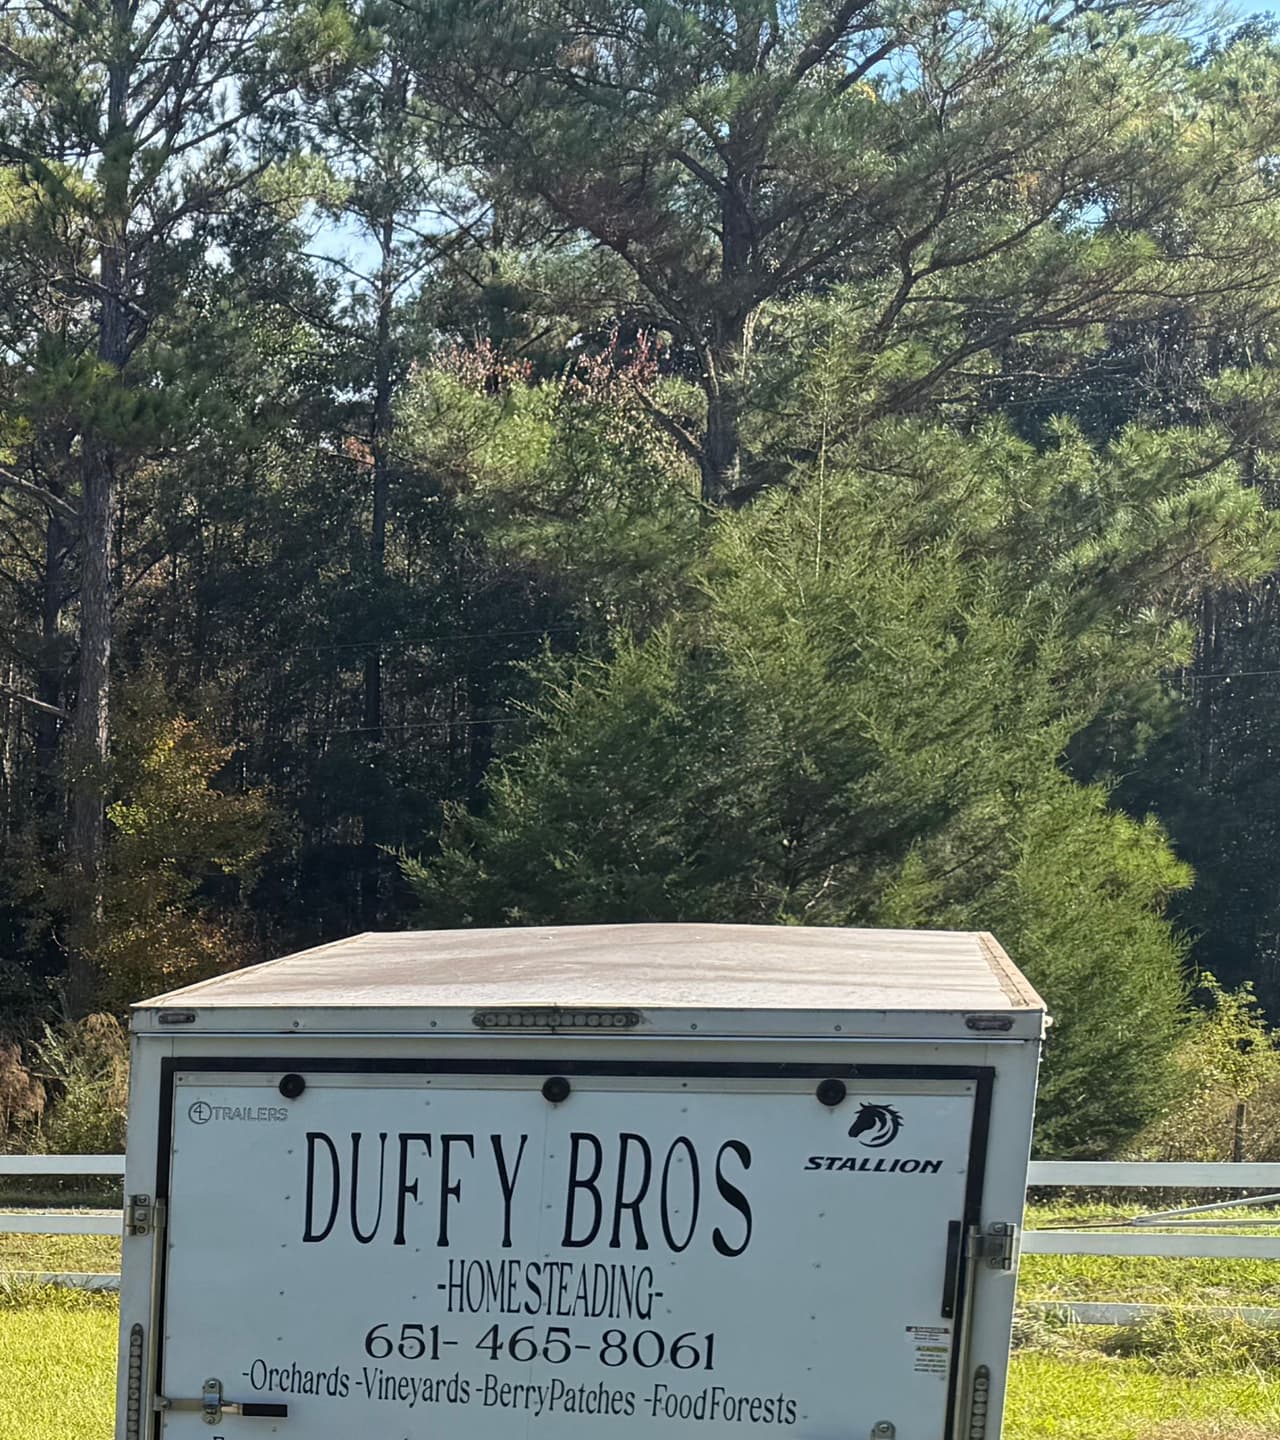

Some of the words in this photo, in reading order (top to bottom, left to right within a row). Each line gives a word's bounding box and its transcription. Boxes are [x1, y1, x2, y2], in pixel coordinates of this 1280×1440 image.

[212, 1105, 289, 1121] TRAILERS
[804, 1156, 943, 1174] STALLION
[302, 1132, 528, 1248] DUFFY
[561, 1132, 752, 1258] BROS
[241, 1358, 350, 1398] -Orchards
[354, 1367, 470, 1409] -Vineyards
